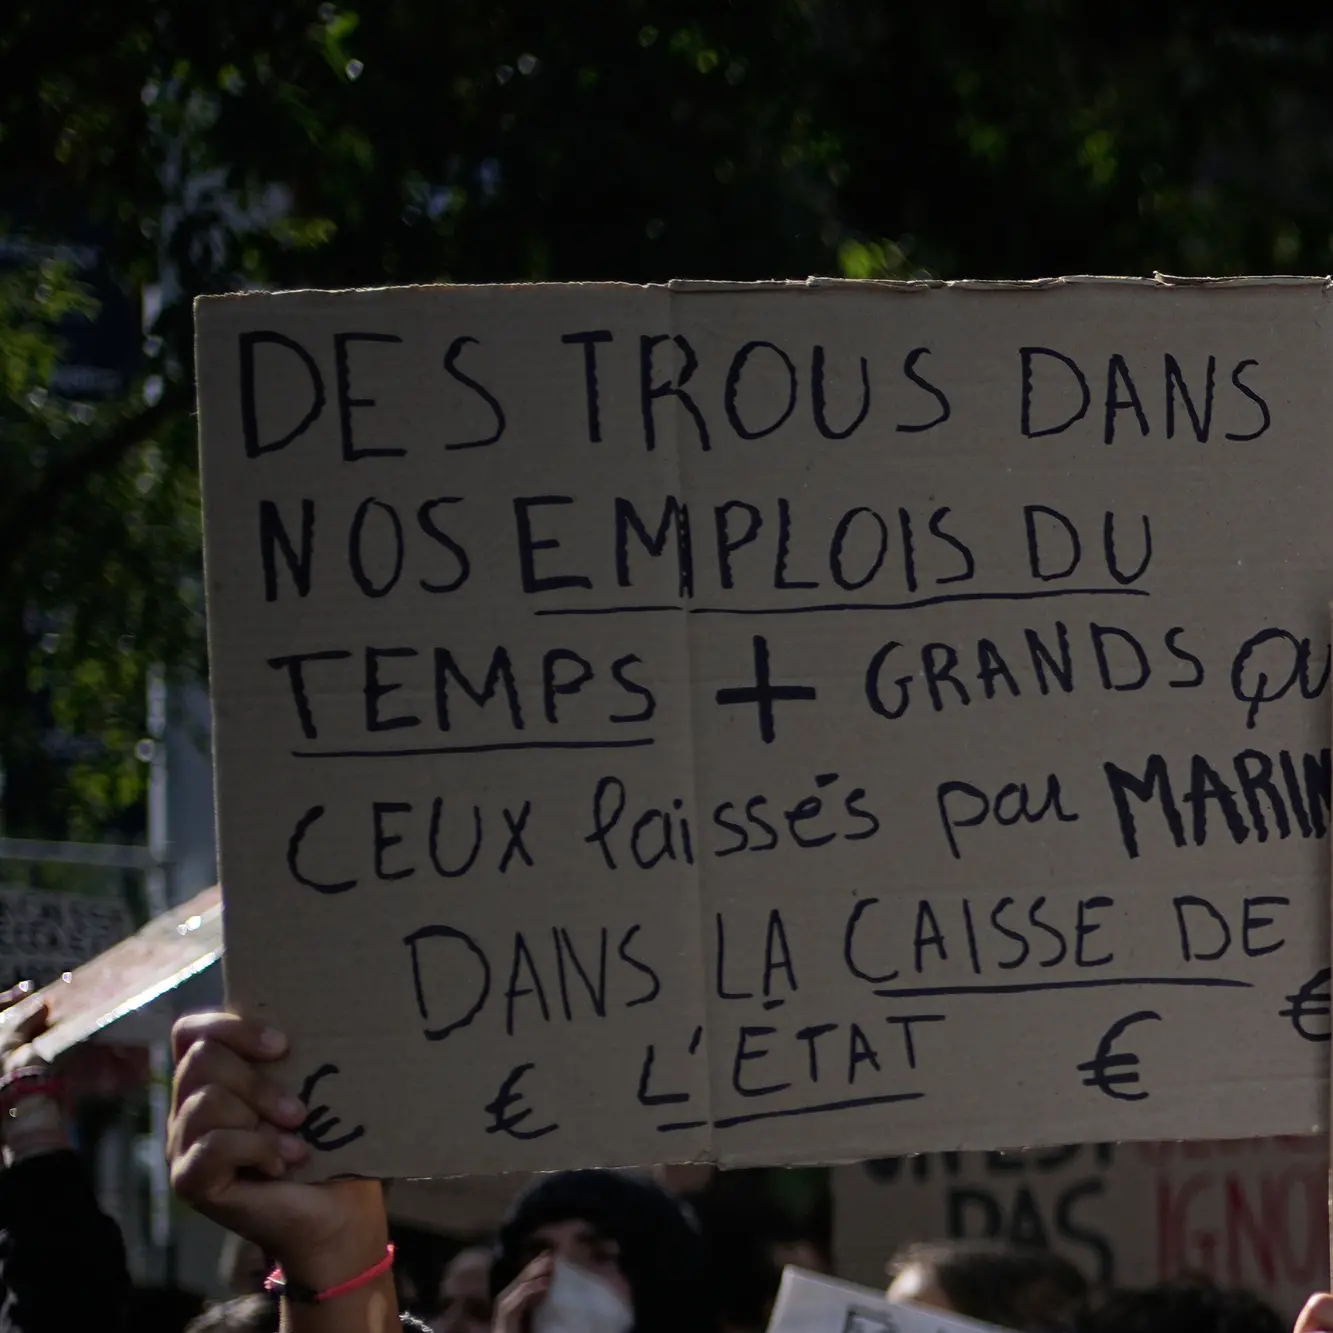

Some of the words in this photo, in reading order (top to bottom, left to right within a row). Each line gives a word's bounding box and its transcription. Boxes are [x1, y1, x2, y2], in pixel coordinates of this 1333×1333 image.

[238, 329, 506, 462] DES
[561, 329, 951, 452] TROUS
[1018, 346, 1271, 445] DANS
[259, 496, 470, 602] NOS
[512, 494, 975, 599] EMPLOIS
[1023, 504, 1153, 585] DU
[267, 645, 657, 740] TEMPS
[864, 619, 1206, 721] GRANDS
[286, 800, 535, 895] CEUX
[584, 771, 881, 871] laissés
[937, 773, 1079, 860] par
[403, 923, 661, 1041] DANS
[716, 908, 799, 1001] LA
[844, 896, 1115, 985] CAISSE
[1172, 895, 1291, 962] DE
